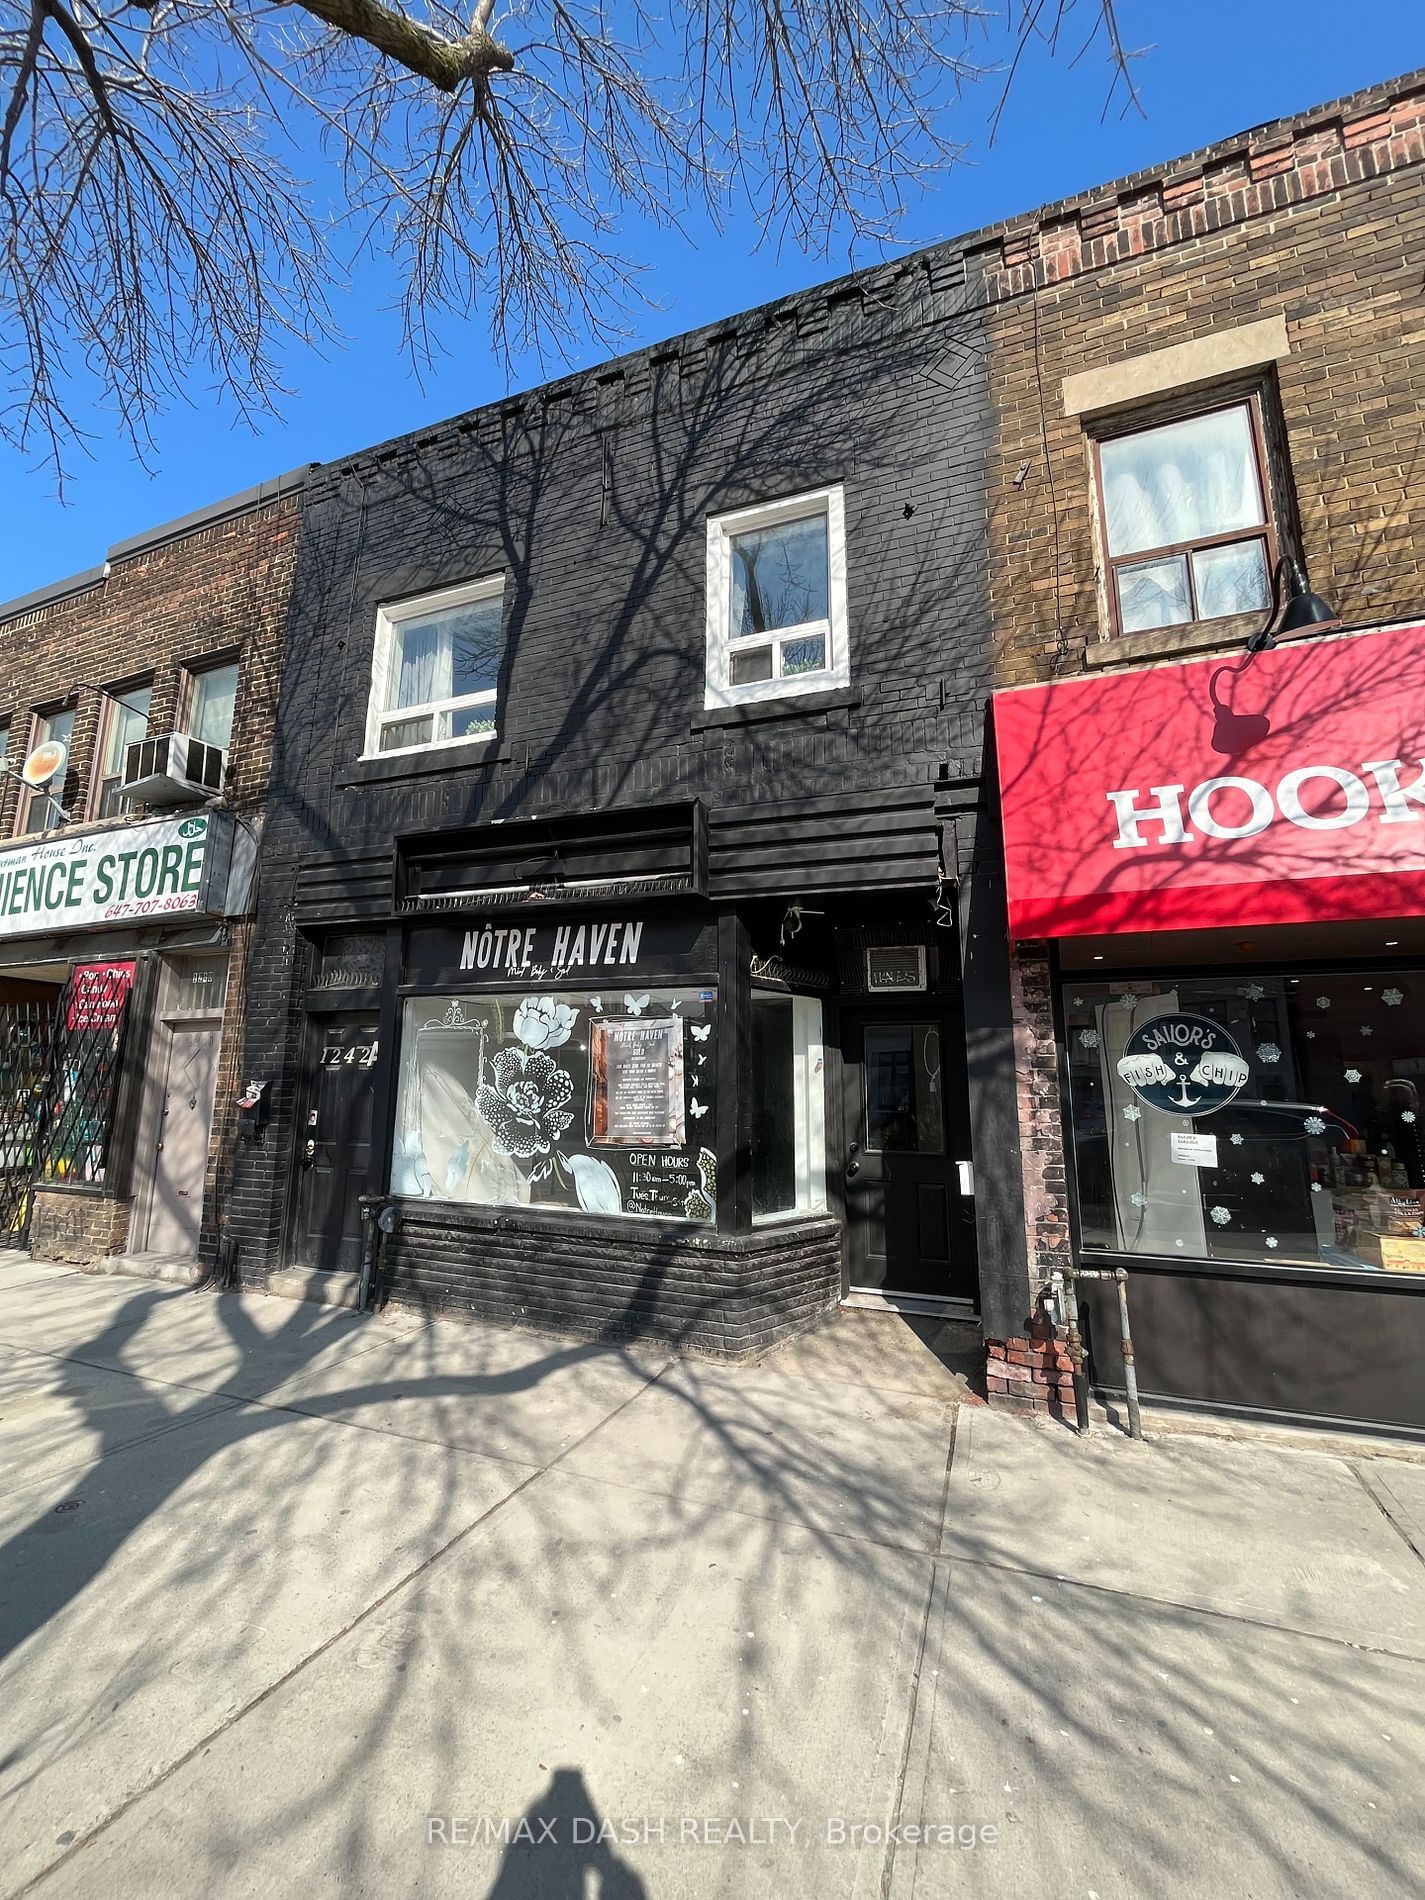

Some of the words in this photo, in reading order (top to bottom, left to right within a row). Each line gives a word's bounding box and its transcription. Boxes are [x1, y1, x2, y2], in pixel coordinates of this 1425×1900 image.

[31, 846, 66, 861] House
[69, 838, 96, 855] Inc.
[93, 840, 206, 905] STORE
[104, 894, 197, 919] 647-707-8063
[459, 924, 537, 970] NÔTRE
[551, 921, 644, 966] HAVEN
[1141, 1023, 1217, 1051] SAILOR'S
[1123, 1064, 1165, 1085] FISH
[1173, 1051, 1190, 1066] &
[1201, 1064, 1248, 1084] CHIP
[629, 1152, 656, 1167] OPEN
[661, 1155, 690, 1169] HOURS
